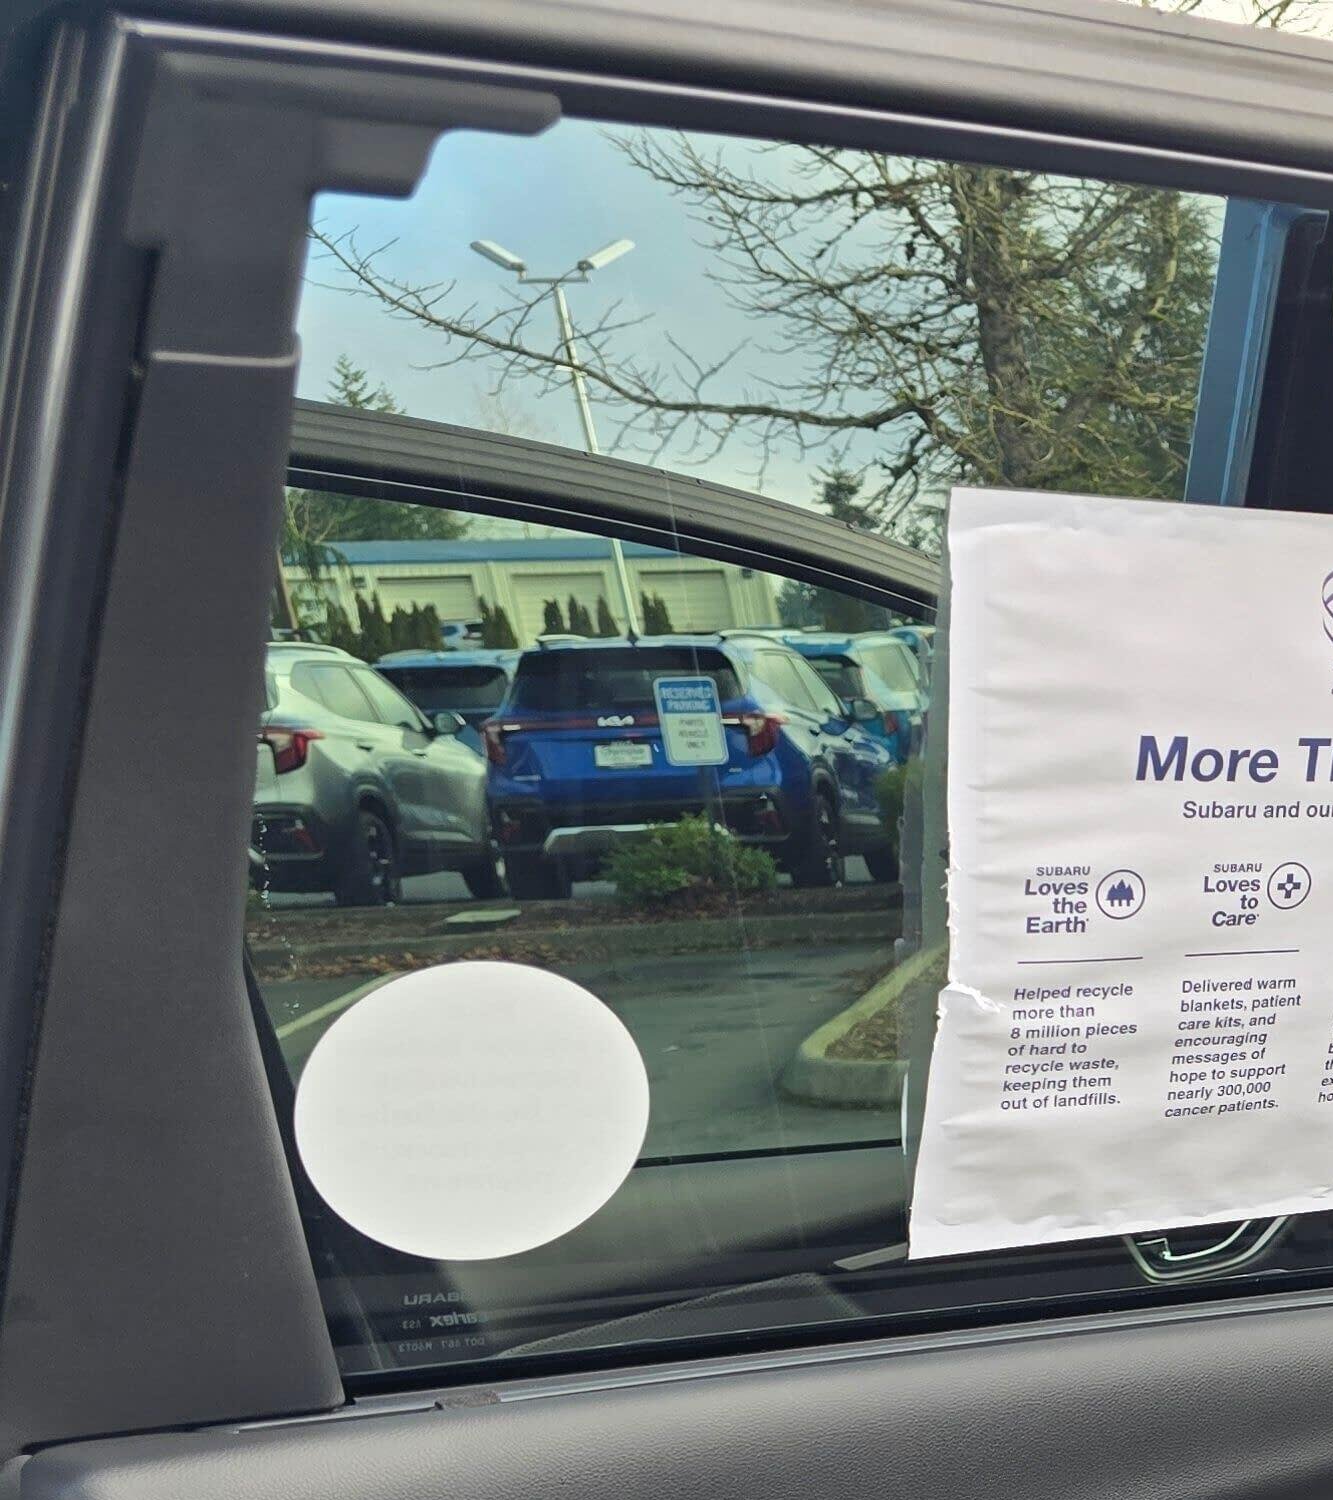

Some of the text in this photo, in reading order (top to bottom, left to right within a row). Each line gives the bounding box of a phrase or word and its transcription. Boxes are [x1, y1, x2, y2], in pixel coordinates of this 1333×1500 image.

[1135, 735, 1279, 783] More
[1182, 800, 1257, 819] Subaru
[1263, 801, 1301, 819] and
[1036, 866, 1091, 877] SUBARU
[1213, 863, 1263, 873] SUBARU
[1024, 879, 1089, 896] Loves
[1203, 876, 1261, 893] Loves
[1052, 897, 1088, 914] the
[1240, 894, 1259, 910] to
[1026, 916, 1086, 934] Earth
[1212, 911, 1257, 927] Care
[1014, 983, 1133, 1003] Helped recycle
[1182, 977, 1296, 993] Delivered warm
[1012, 1004, 1095, 1020] more than
[1180, 994, 1302, 1013] blankets, patient
[1177, 1013, 1277, 1031] care kits, and
[1010, 1023, 1137, 1040] 8 million pieces
[1174, 1031, 1268, 1048] encouraging
[1008, 1042, 1087, 1056] of hard to
[1171, 1047, 1266, 1065] messages of
[1005, 1058, 1119, 1076] recycle waste,
[1169, 1064, 1286, 1085] hope to support
[1003, 1075, 1112, 1094] keeping them
[1167, 1081, 1271, 1101] nearly 300,000
[1000, 1092, 1120, 1110] out of landfills.
[1164, 1098, 1279, 1117] cancer patients.
